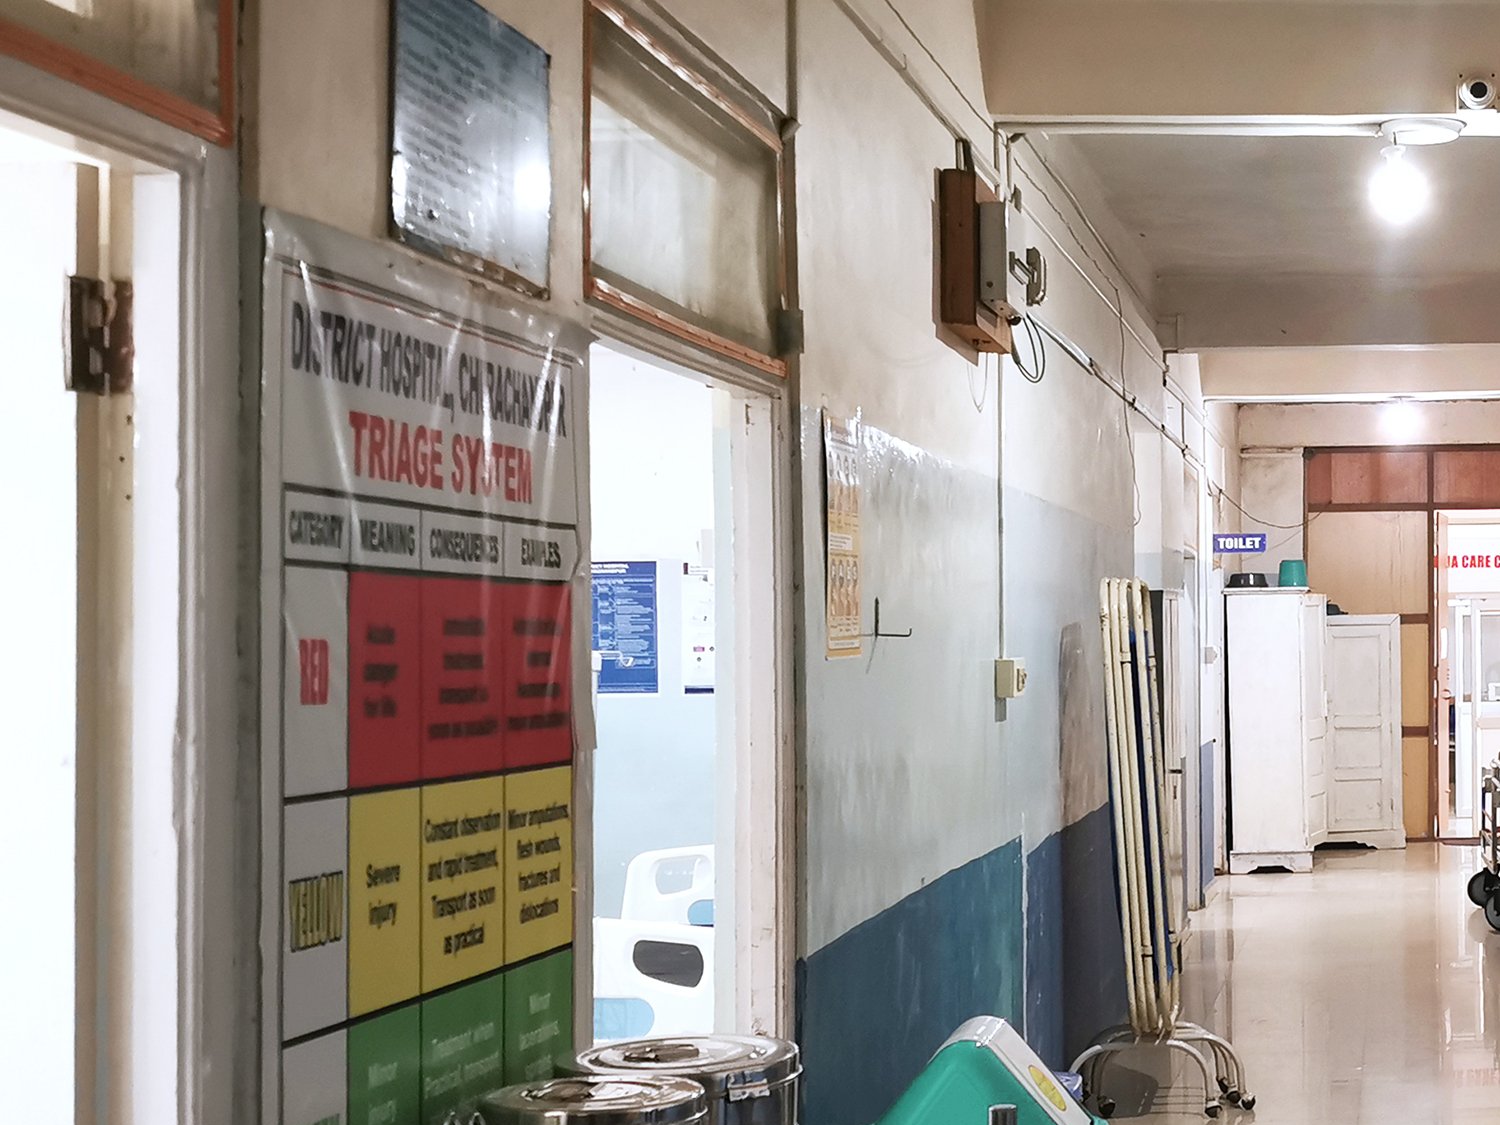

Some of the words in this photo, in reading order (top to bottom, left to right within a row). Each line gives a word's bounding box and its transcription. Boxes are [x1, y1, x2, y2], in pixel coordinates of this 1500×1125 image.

[291, 301, 375, 388] DISTRICT
[349, 411, 443, 490] TRIAGE
[451, 434, 532, 504] SYSTEM
[289, 511, 343, 549] CATEGORY
[360, 519, 415, 556] MEANING
[1217, 537, 1262, 549] TOILET
[1462, 555, 1490, 568] CARE
[299, 639, 328, 705] RED
[289, 870, 343, 953] YELLOW
